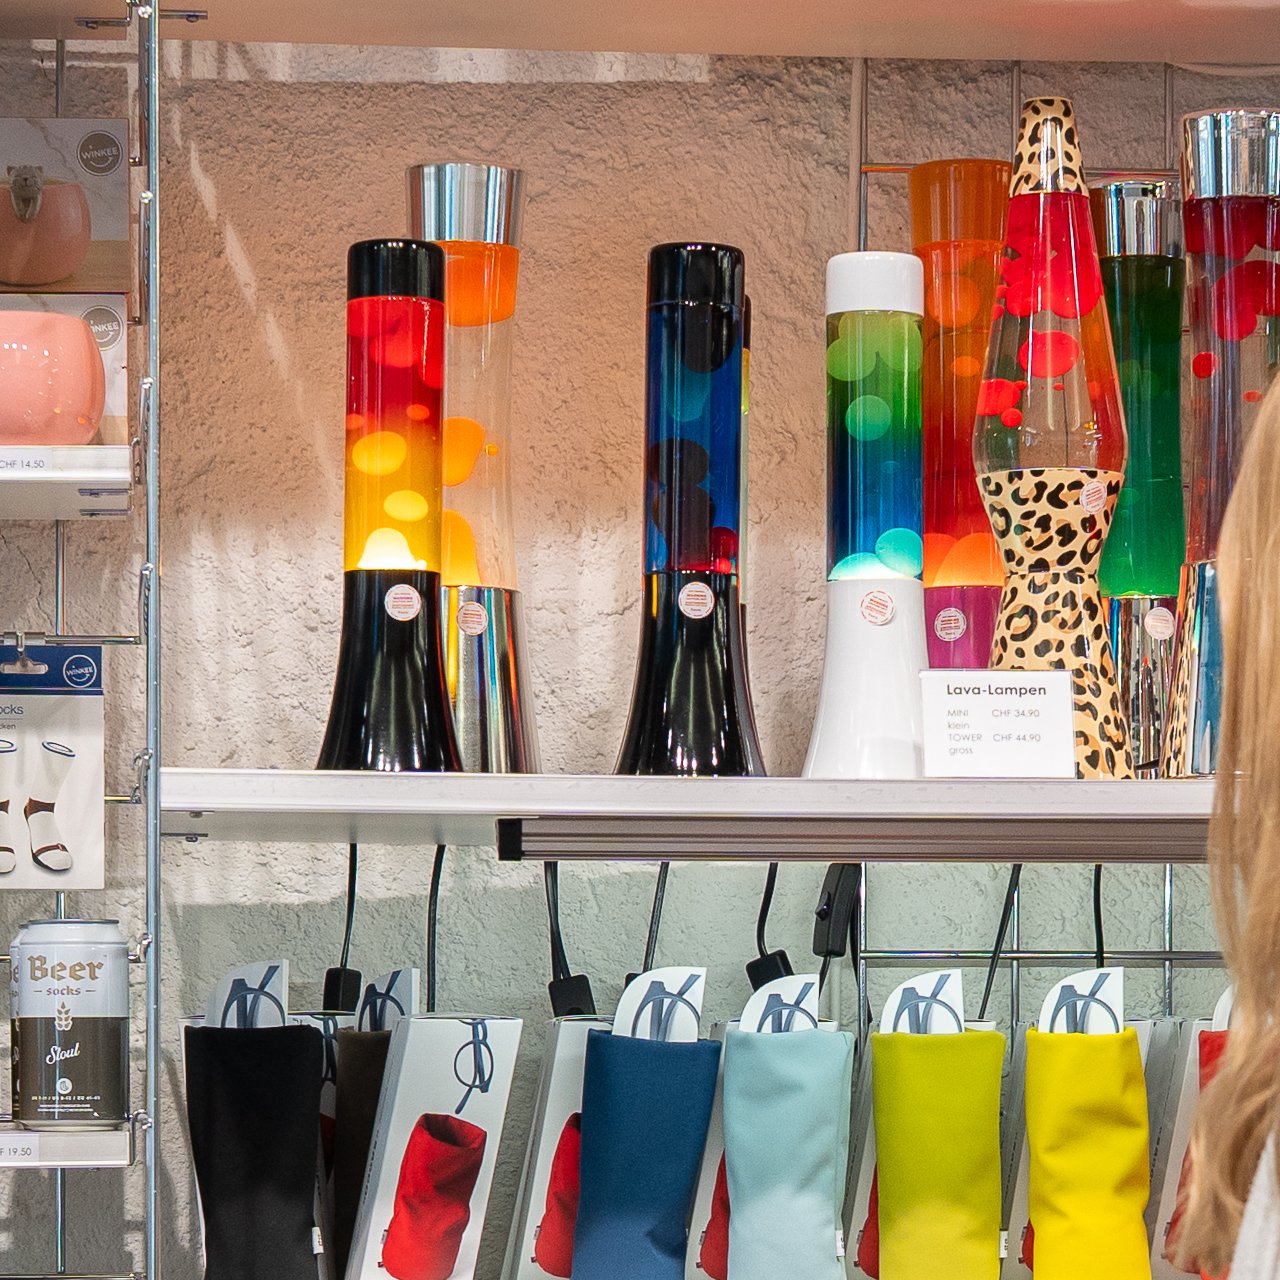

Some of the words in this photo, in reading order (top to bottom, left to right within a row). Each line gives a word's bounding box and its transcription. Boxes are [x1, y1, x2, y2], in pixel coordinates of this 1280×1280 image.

[80, 147, 120, 160] WINKEE
[20, 459, 45, 469] 14.50
[947, 684, 1046, 697] Lava-Lampen
[992, 709, 1011, 717] CHF
[1014, 709, 1040, 718] 34.90
[949, 734, 982, 742] TOWER
[993, 734, 1012, 742] CHF
[1016, 734, 1041, 742] 44.90
[949, 747, 973, 755] gross
[28, 955, 104, 982] Beer
[46, 986, 81, 996] socks
[46, 1042, 81, 1065] Stout
[8, 1147, 32, 1156] 19.50
